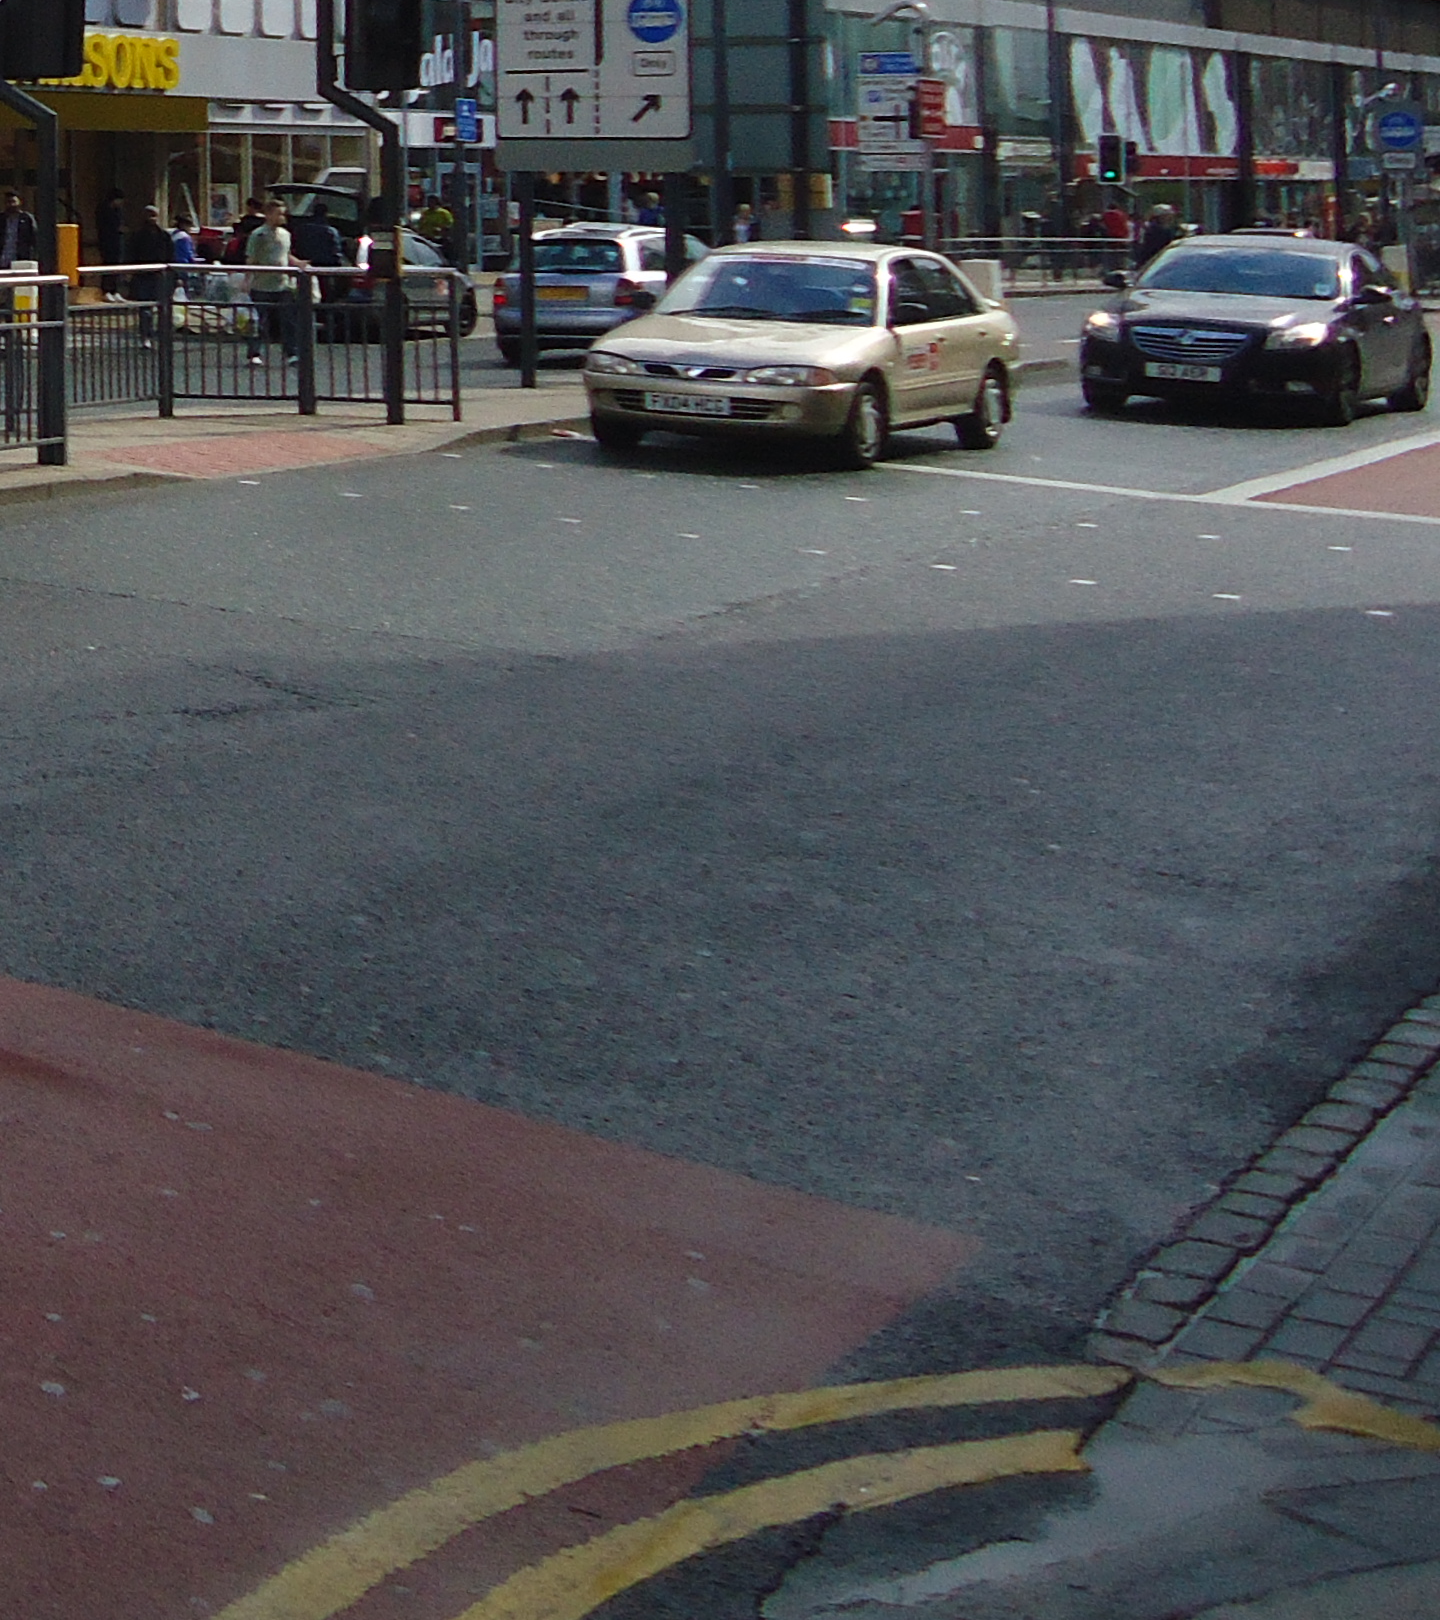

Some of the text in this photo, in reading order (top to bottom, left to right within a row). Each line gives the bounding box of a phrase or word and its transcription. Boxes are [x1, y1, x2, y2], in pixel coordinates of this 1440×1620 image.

[524, 9, 576, 22] and all
[523, 28, 580, 43] through
[528, 49, 575, 60] routes
